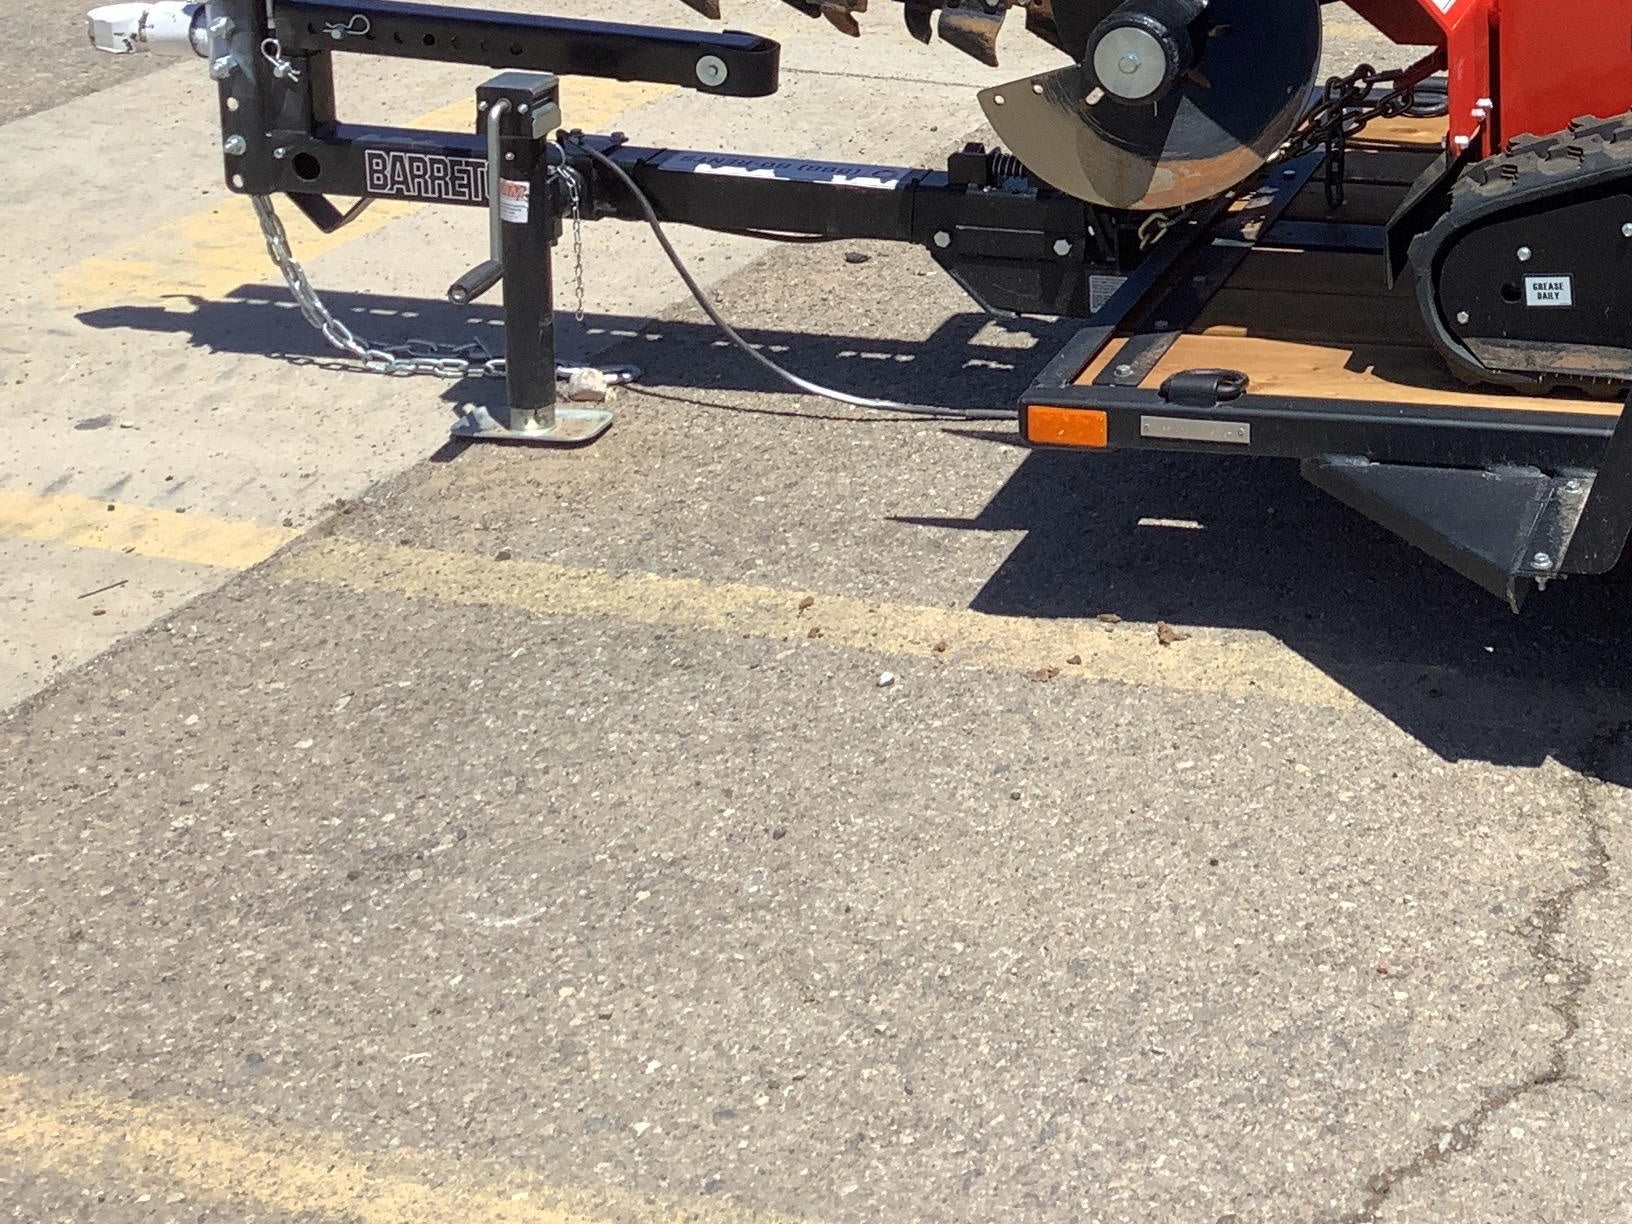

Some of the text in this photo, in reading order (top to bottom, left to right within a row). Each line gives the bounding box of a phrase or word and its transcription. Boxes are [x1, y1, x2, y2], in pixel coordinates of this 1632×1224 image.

[365, 149, 490, 201] BARRET
[1532, 282, 1564, 291] GREASE
[1537, 291, 1560, 300] DAILY
